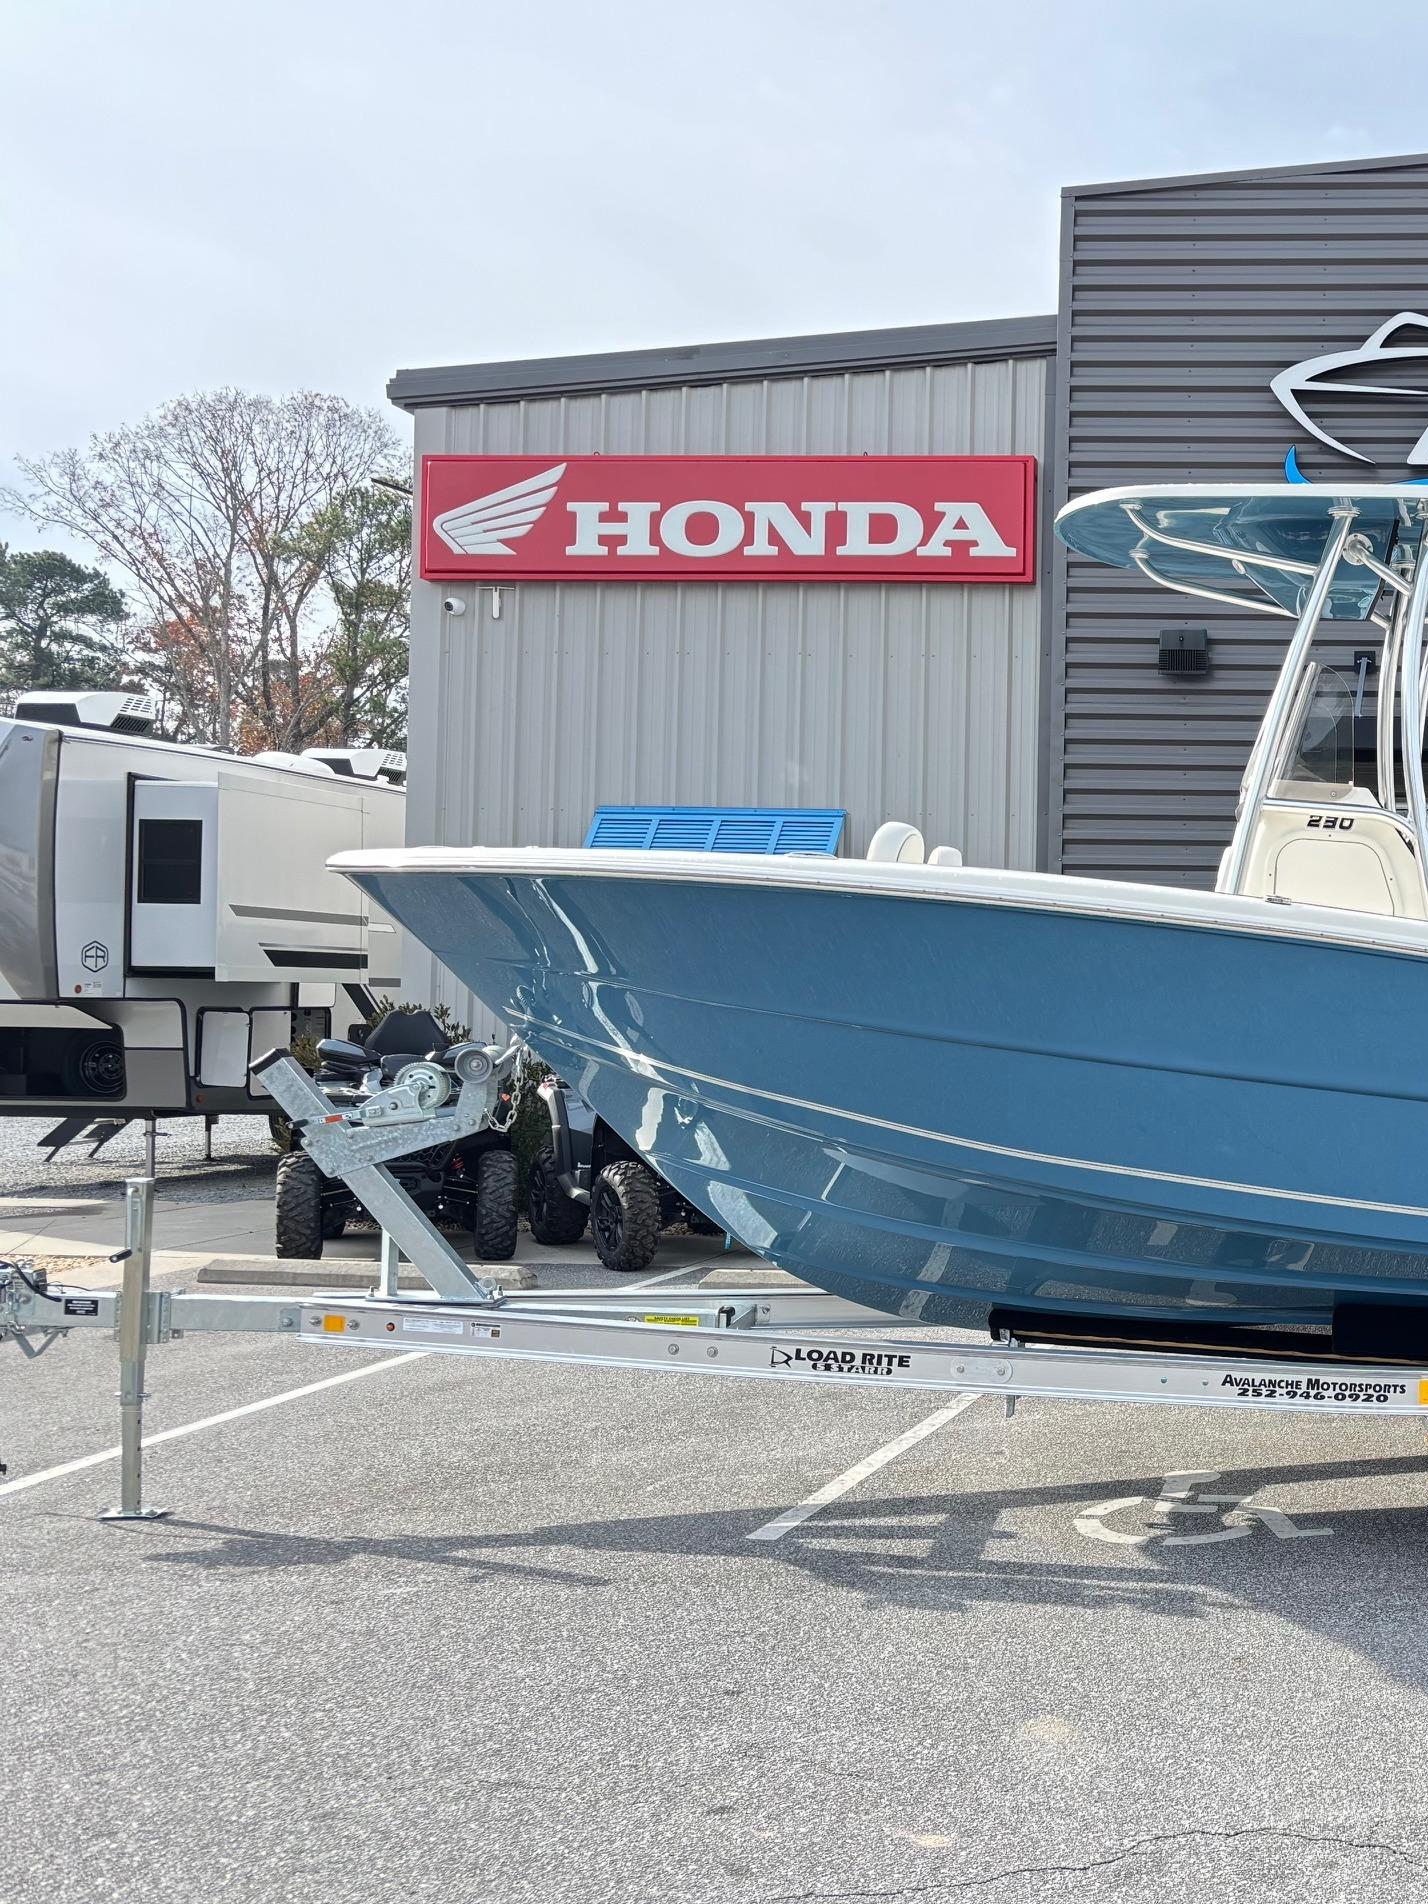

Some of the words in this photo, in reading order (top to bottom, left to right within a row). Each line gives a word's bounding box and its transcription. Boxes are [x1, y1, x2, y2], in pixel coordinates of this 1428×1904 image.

[566, 500, 1017, 558] HONDA
[1307, 815, 1355, 830] 230
[794, 1348, 856, 1364] LOAD
[861, 1352, 912, 1368] RITE
[1236, 1387, 1390, 1403] 252-946-0920
